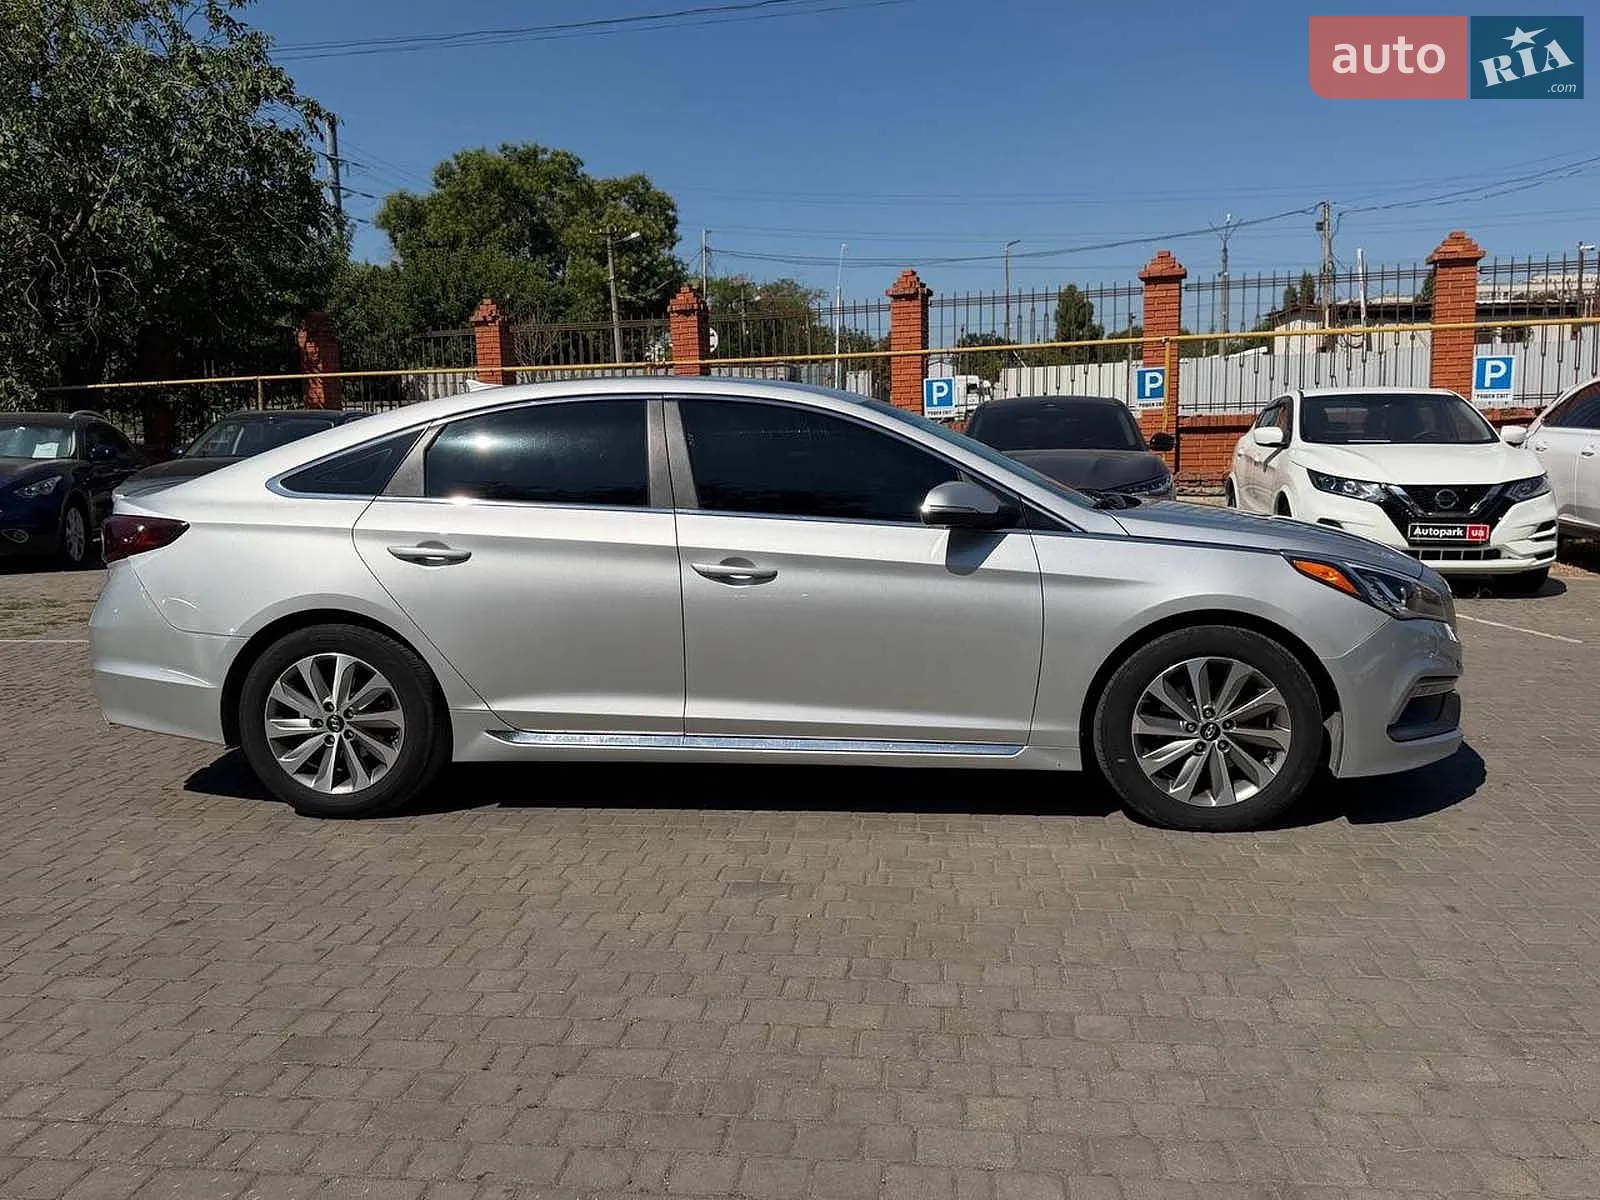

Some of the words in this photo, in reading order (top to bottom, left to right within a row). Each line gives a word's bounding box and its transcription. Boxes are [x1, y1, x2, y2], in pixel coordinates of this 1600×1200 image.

[1145, 371, 1163, 397] P
[1484, 360, 1507, 388] P
[932, 381, 949, 405] P
[1413, 526, 1464, 538] Autopark
